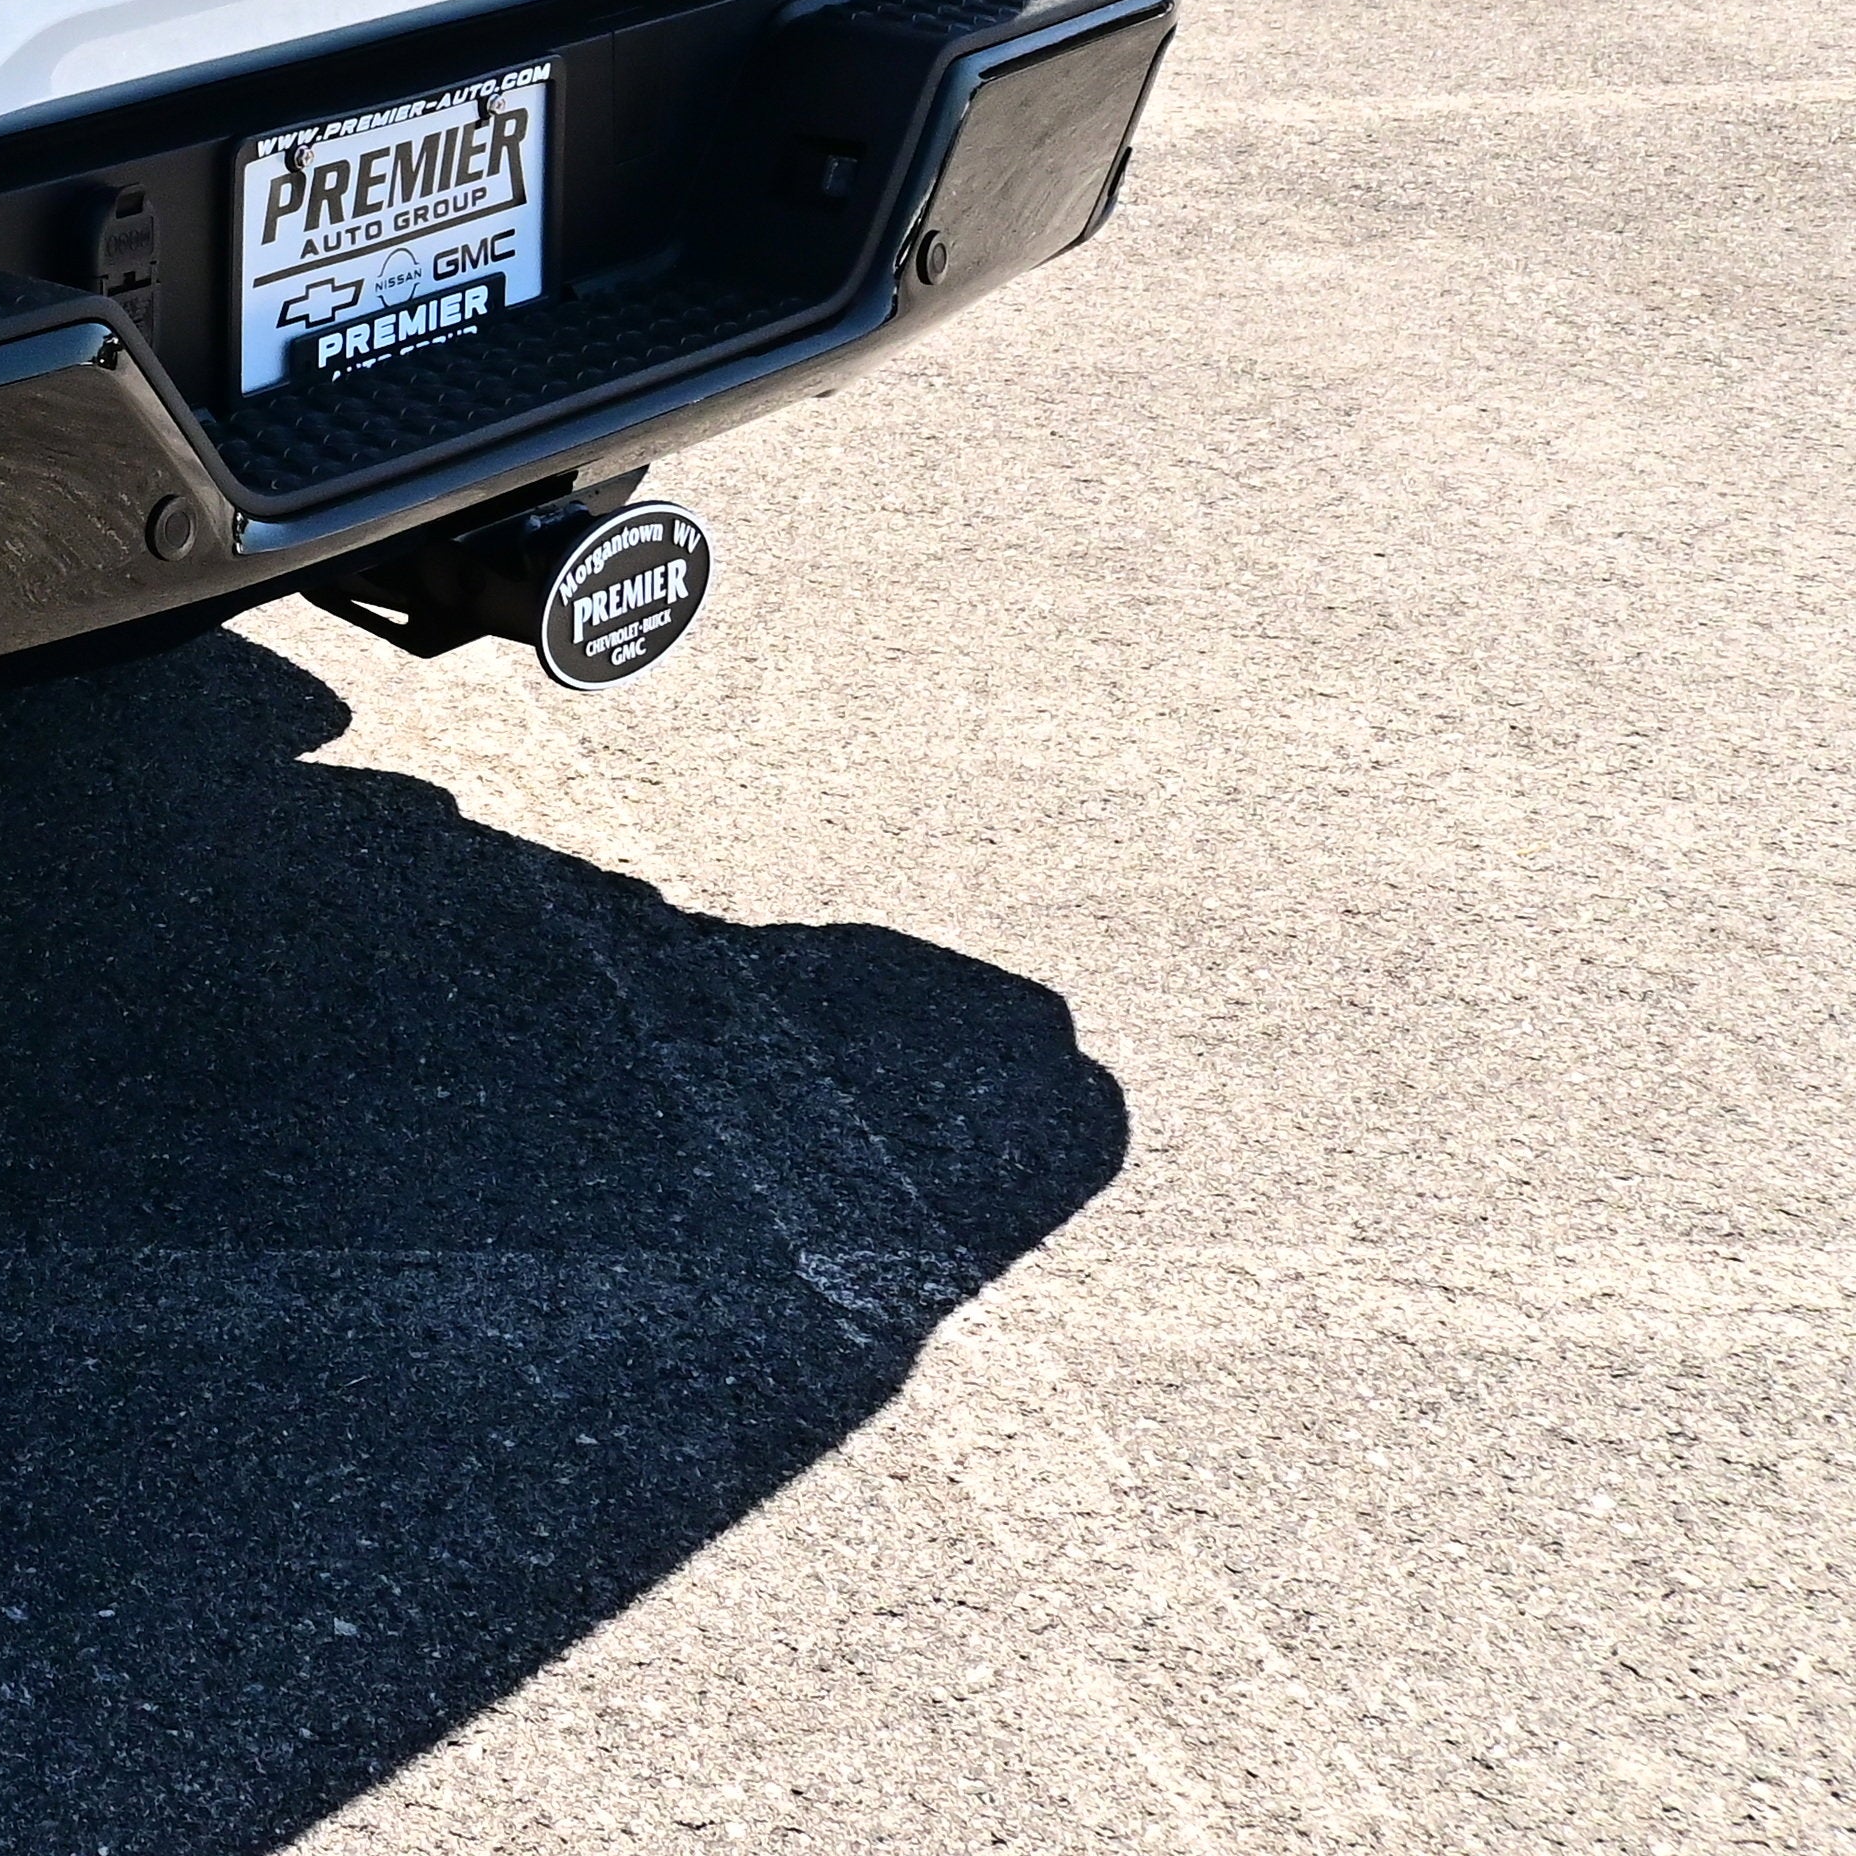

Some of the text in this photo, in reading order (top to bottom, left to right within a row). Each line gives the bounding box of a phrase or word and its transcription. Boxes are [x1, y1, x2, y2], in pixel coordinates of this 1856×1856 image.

[257, 63, 551, 157] WWW.PREMIER-AUTO.COM
[261, 108, 529, 246] PREMIER
[300, 186, 488, 260] AUTO GROUP
[375, 229, 516, 292] NISSAN GMC
[318, 284, 488, 369] PREMIER
[559, 519, 701, 607] Morgantown WV
[573, 558, 689, 644] PREMIER
[611, 637, 647, 666] GMC
